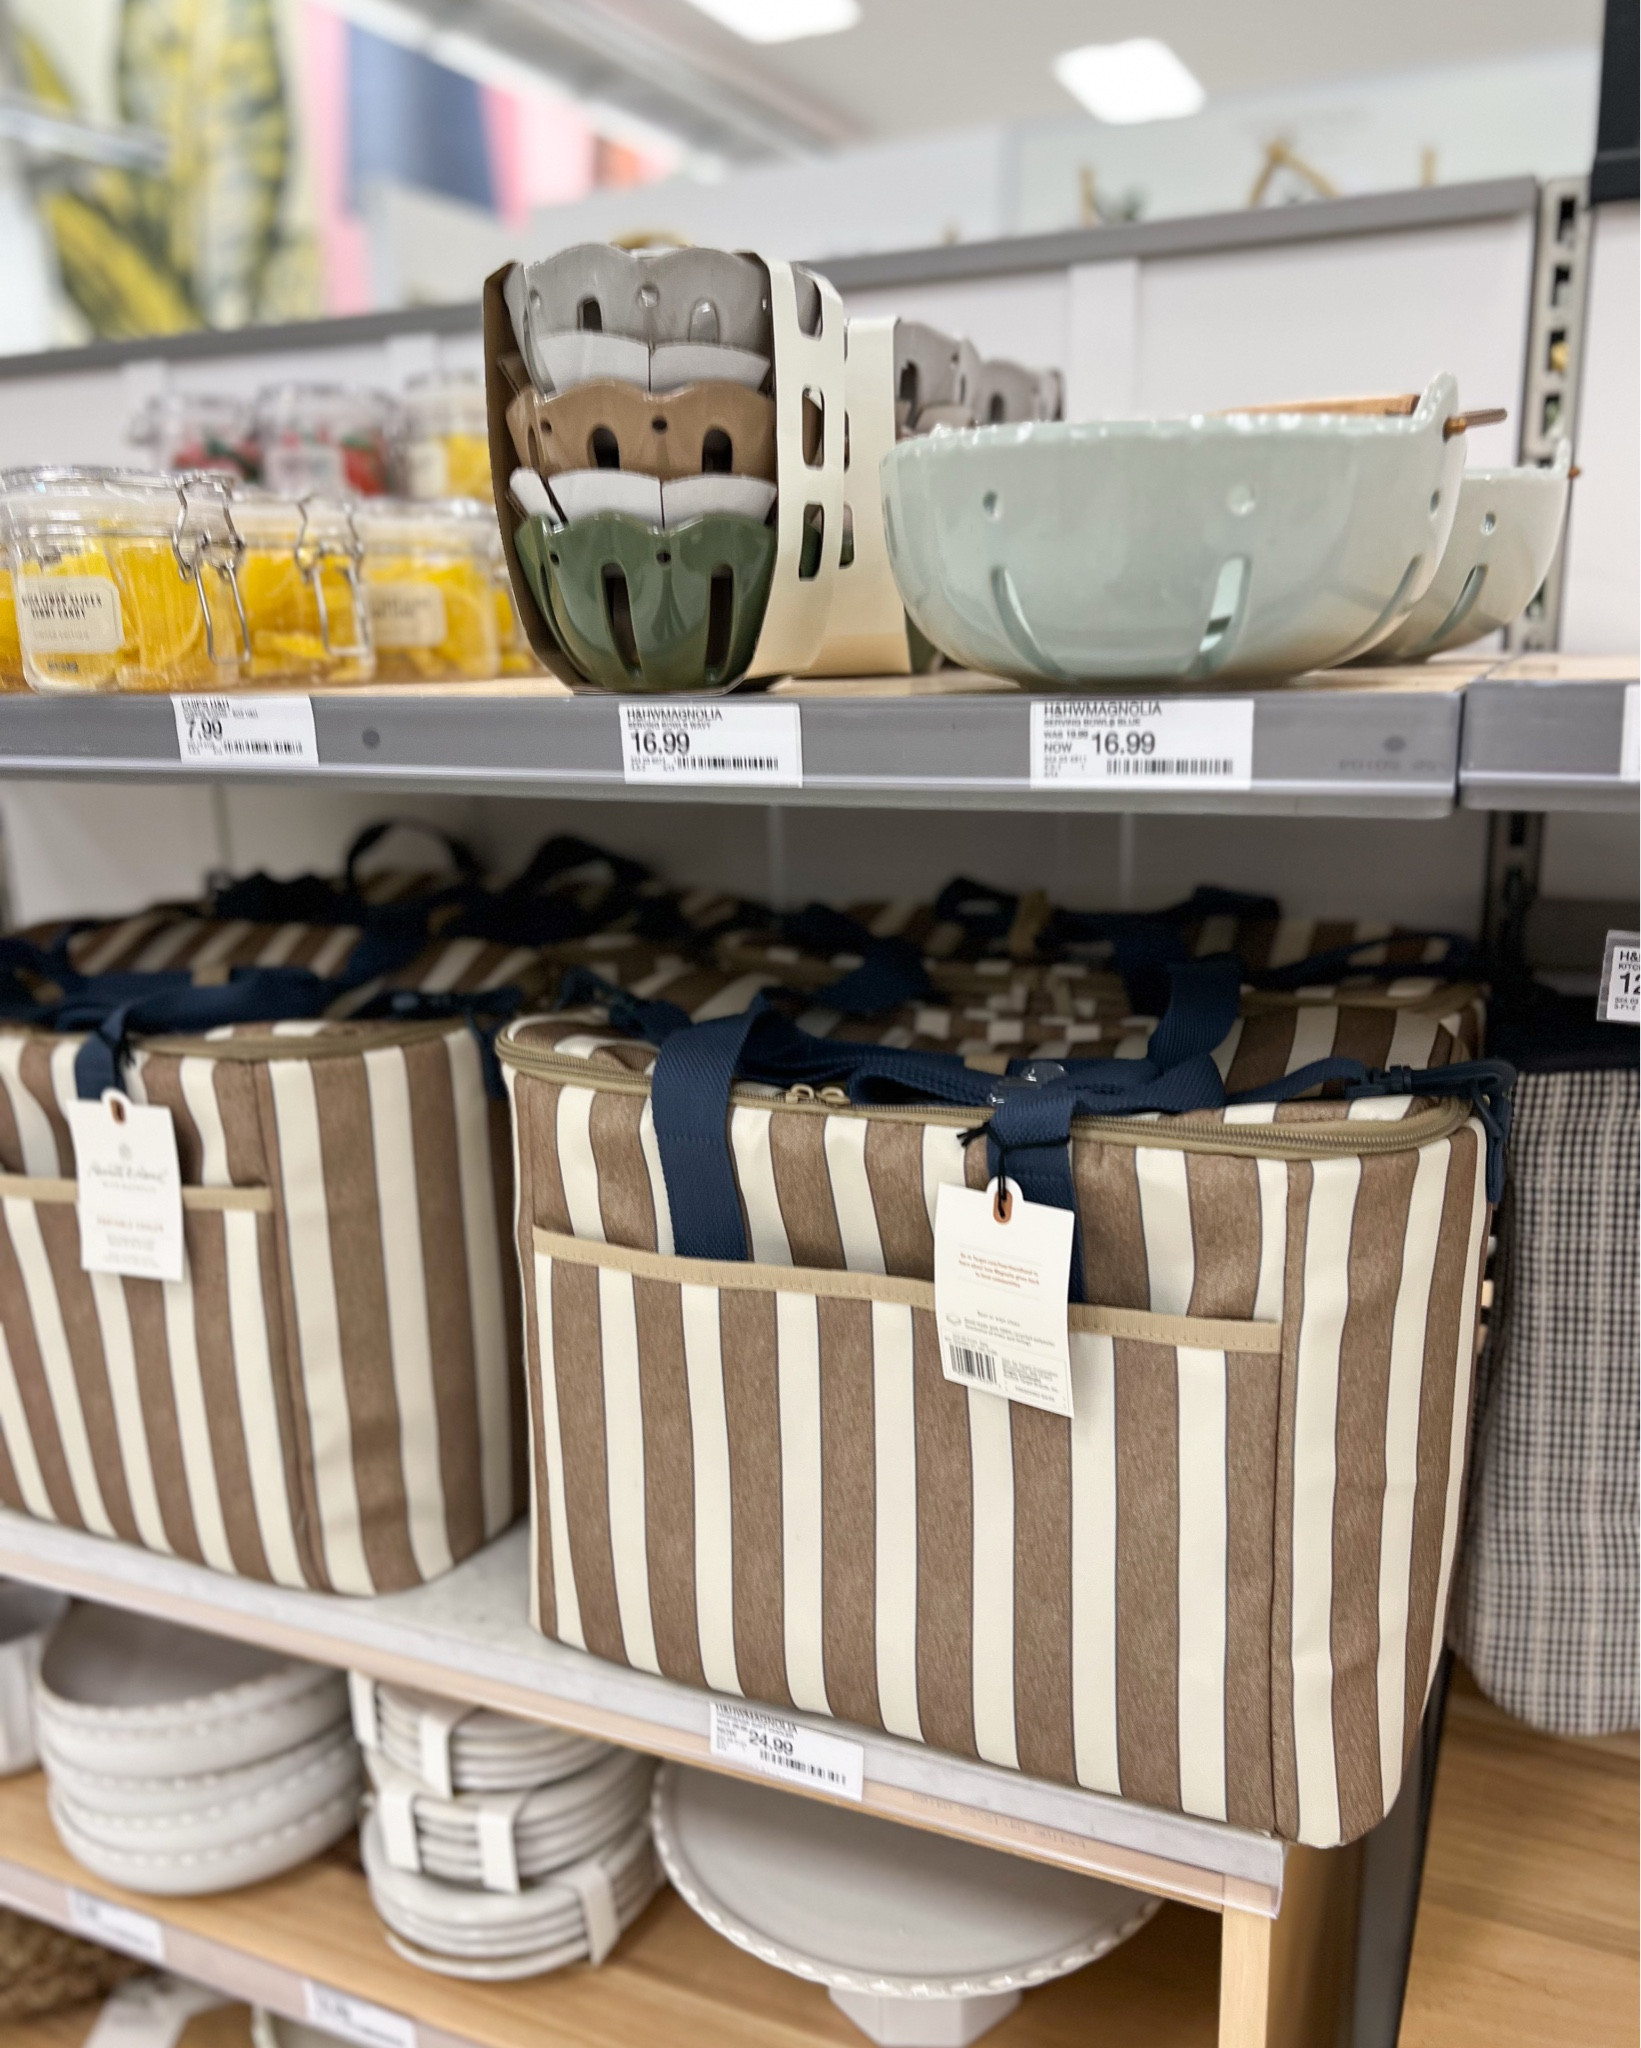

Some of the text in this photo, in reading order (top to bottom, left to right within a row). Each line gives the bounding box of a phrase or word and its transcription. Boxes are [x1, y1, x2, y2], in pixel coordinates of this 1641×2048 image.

[627, 708, 723, 720] H&HWMAGNOLIA
[1044, 701, 1161, 715] H&HWMAGNOLIA
[186, 718, 223, 740] 7.99
[631, 731, 690, 754] 16.99
[1044, 742, 1072, 752] NOW
[1092, 730, 1156, 755] 16.99
[1620, 951, 1640, 961] H&
[1618, 963, 1640, 971] KITC
[750, 1730, 793, 1755] 24.99
